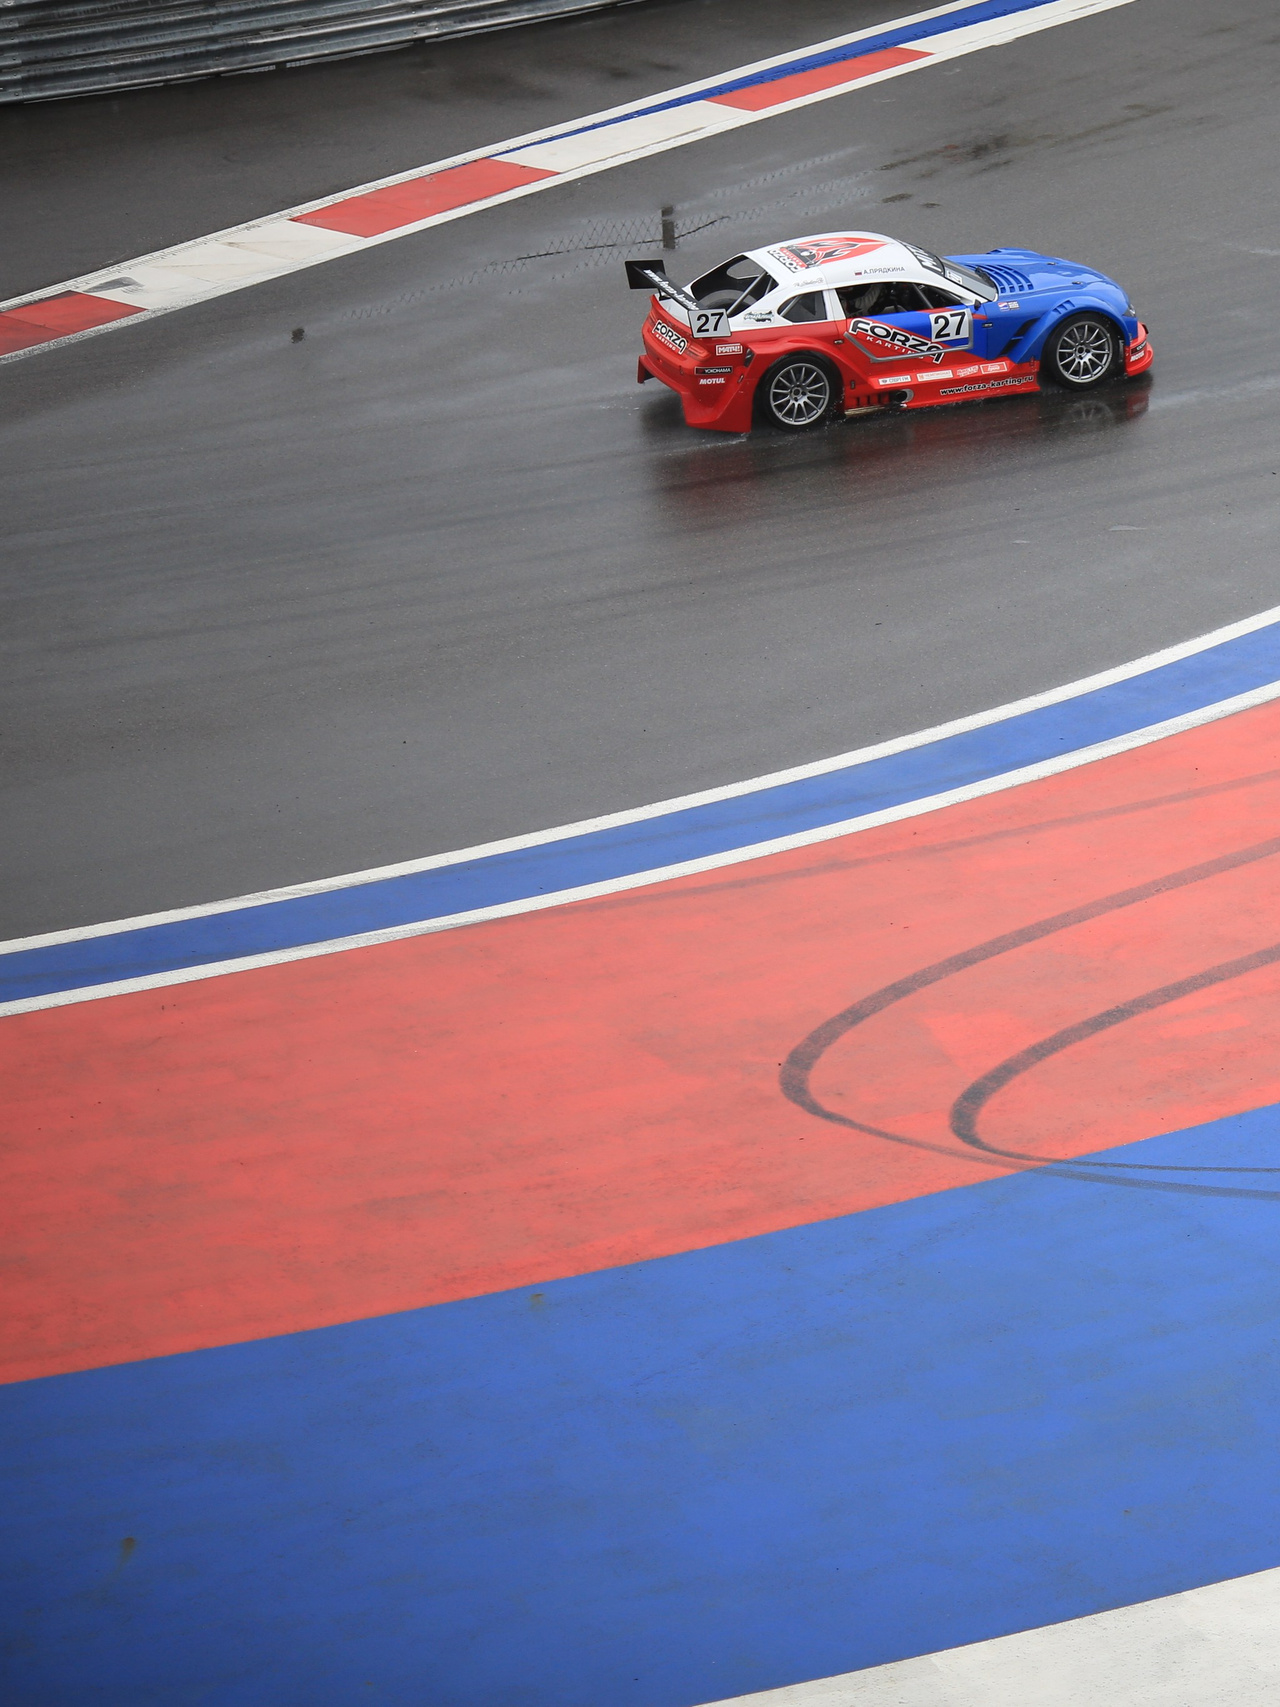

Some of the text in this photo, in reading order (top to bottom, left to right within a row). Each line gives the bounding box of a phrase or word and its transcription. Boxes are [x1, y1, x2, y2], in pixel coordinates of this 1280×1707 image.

[696, 312, 724, 334] 27
[934, 311, 966, 340] 27
[652, 320, 688, 355] FORZA
[849, 317, 945, 364] FORZA
[866, 336, 924, 360] KARTIN
[699, 377, 726, 385] MOTUL
[939, 375, 1034, 396] www.forza-karting.ru
